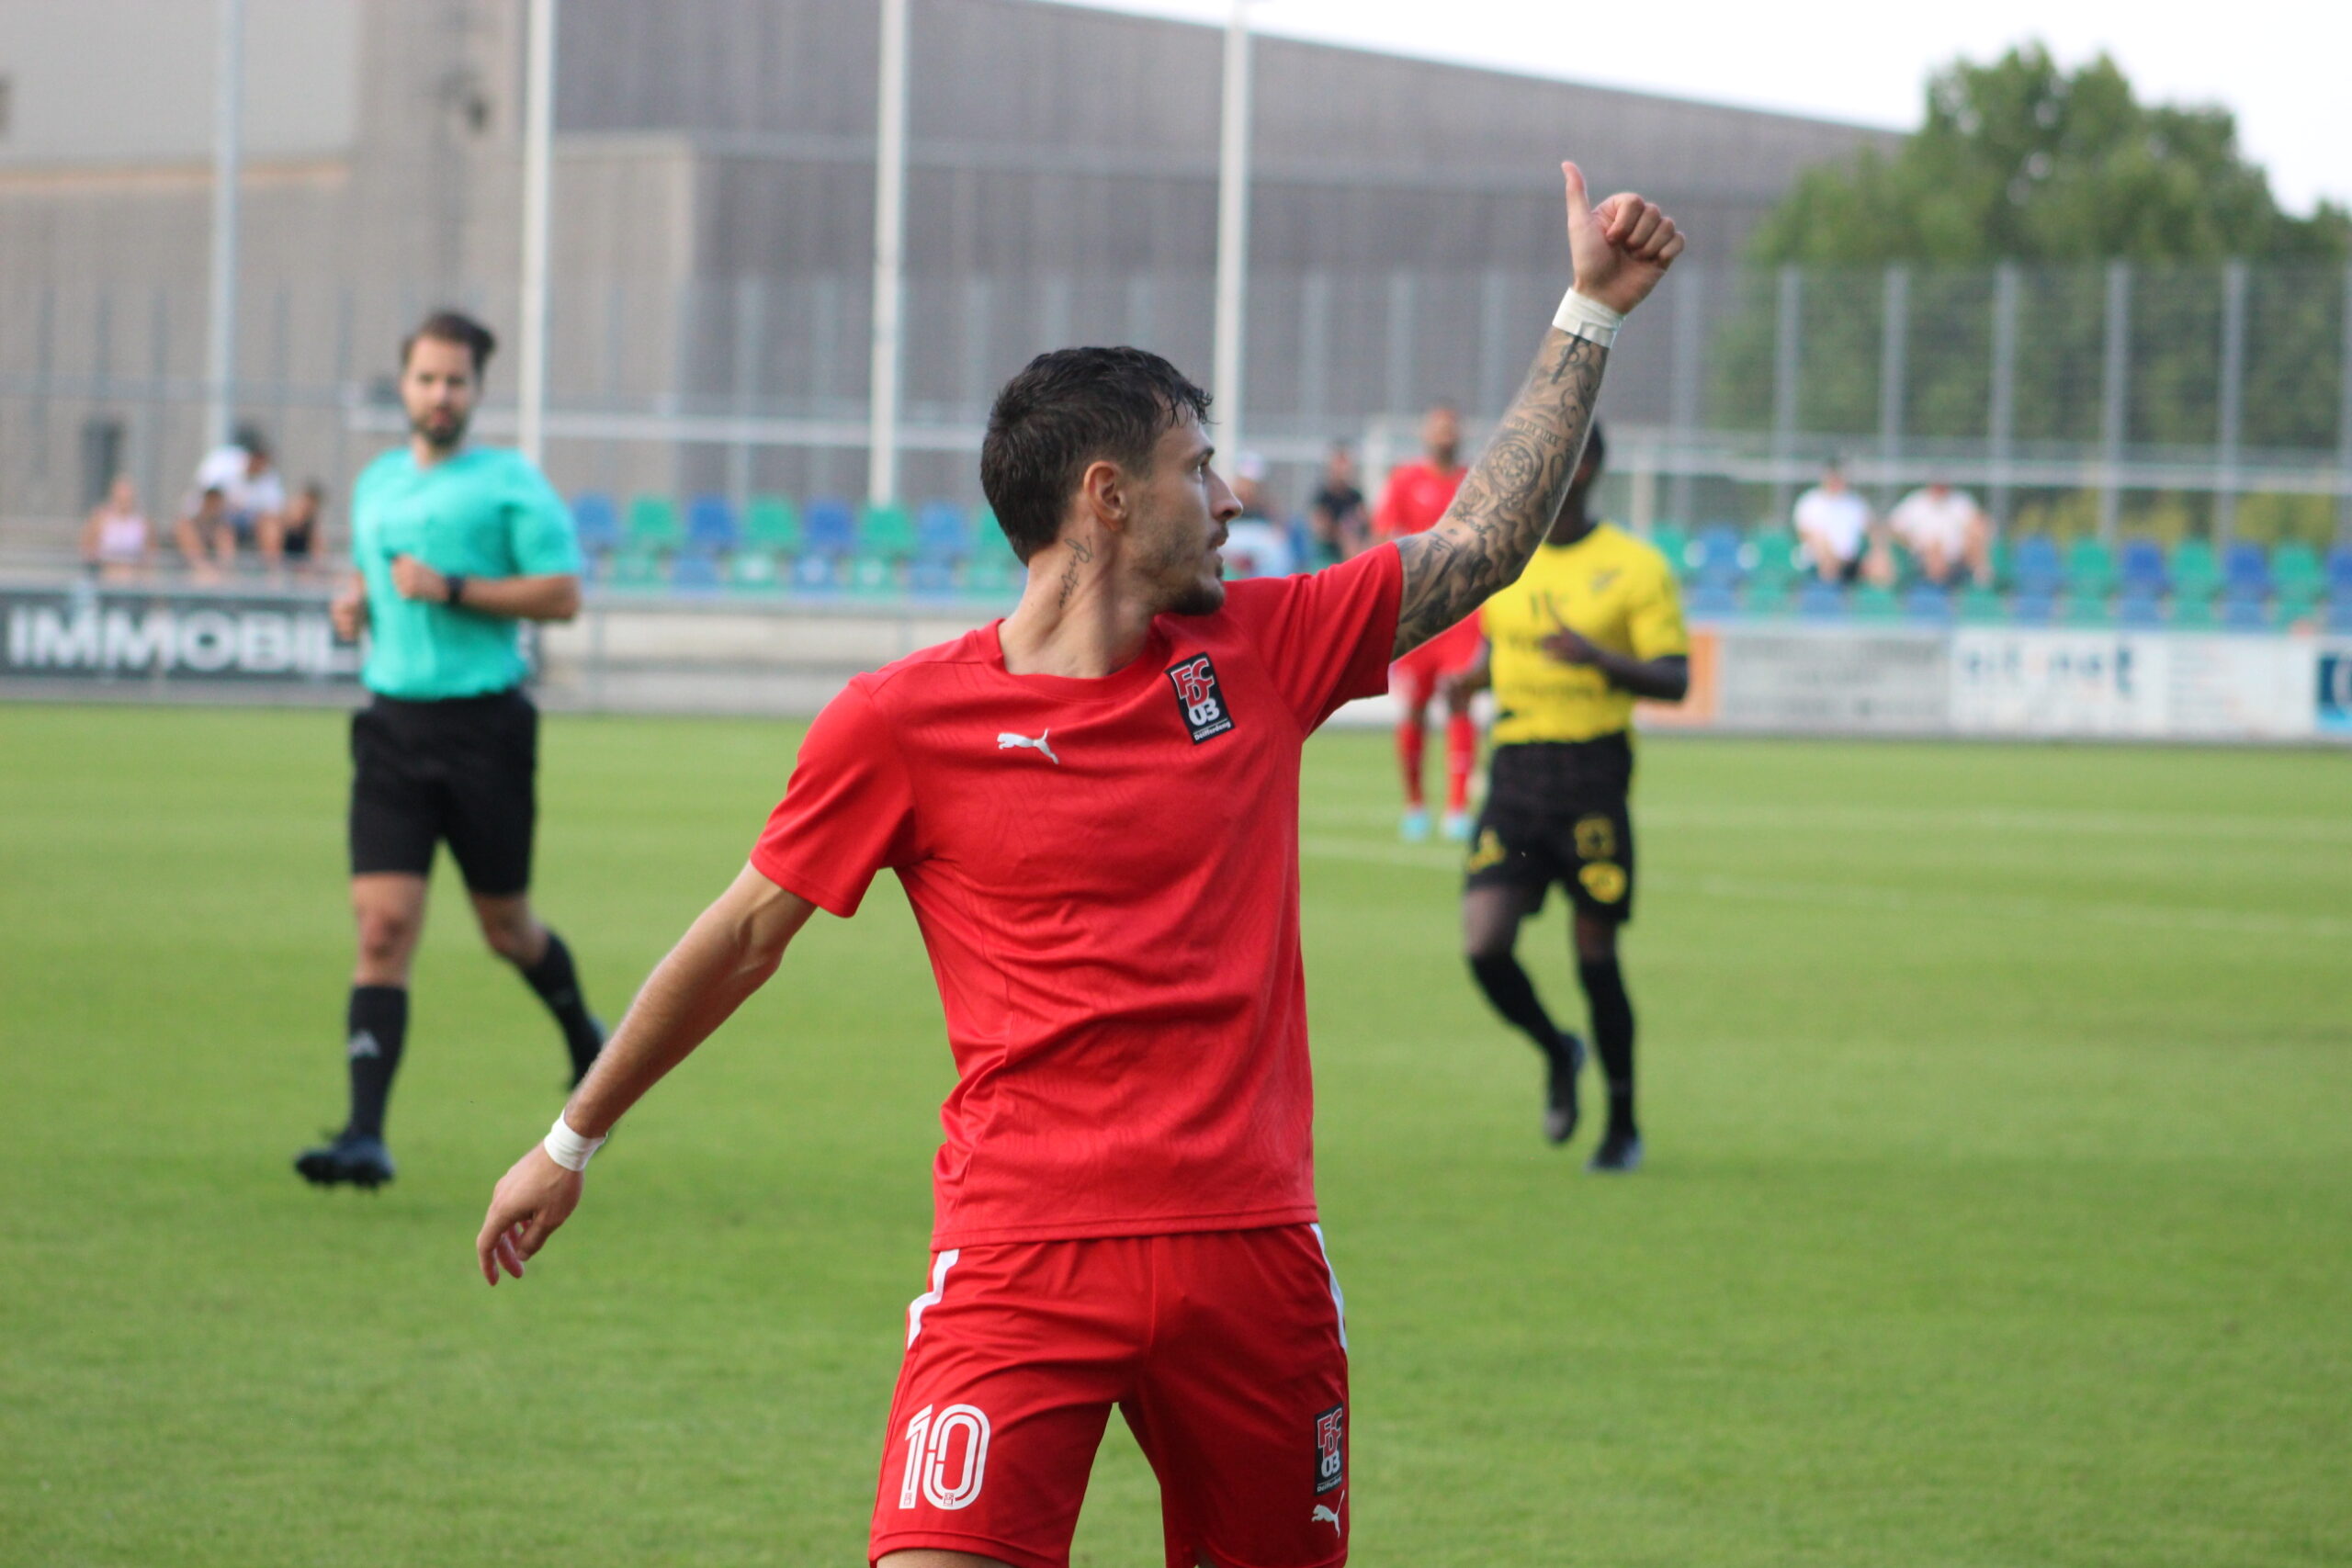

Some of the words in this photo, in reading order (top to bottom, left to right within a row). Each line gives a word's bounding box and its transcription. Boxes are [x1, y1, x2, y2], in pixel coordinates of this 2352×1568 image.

[9, 606, 370, 673] IMMOBIL
[1188, 697, 1220, 726] 03
[899, 1403, 991, 1510] 10
[1320, 1450, 1341, 1478] 03
